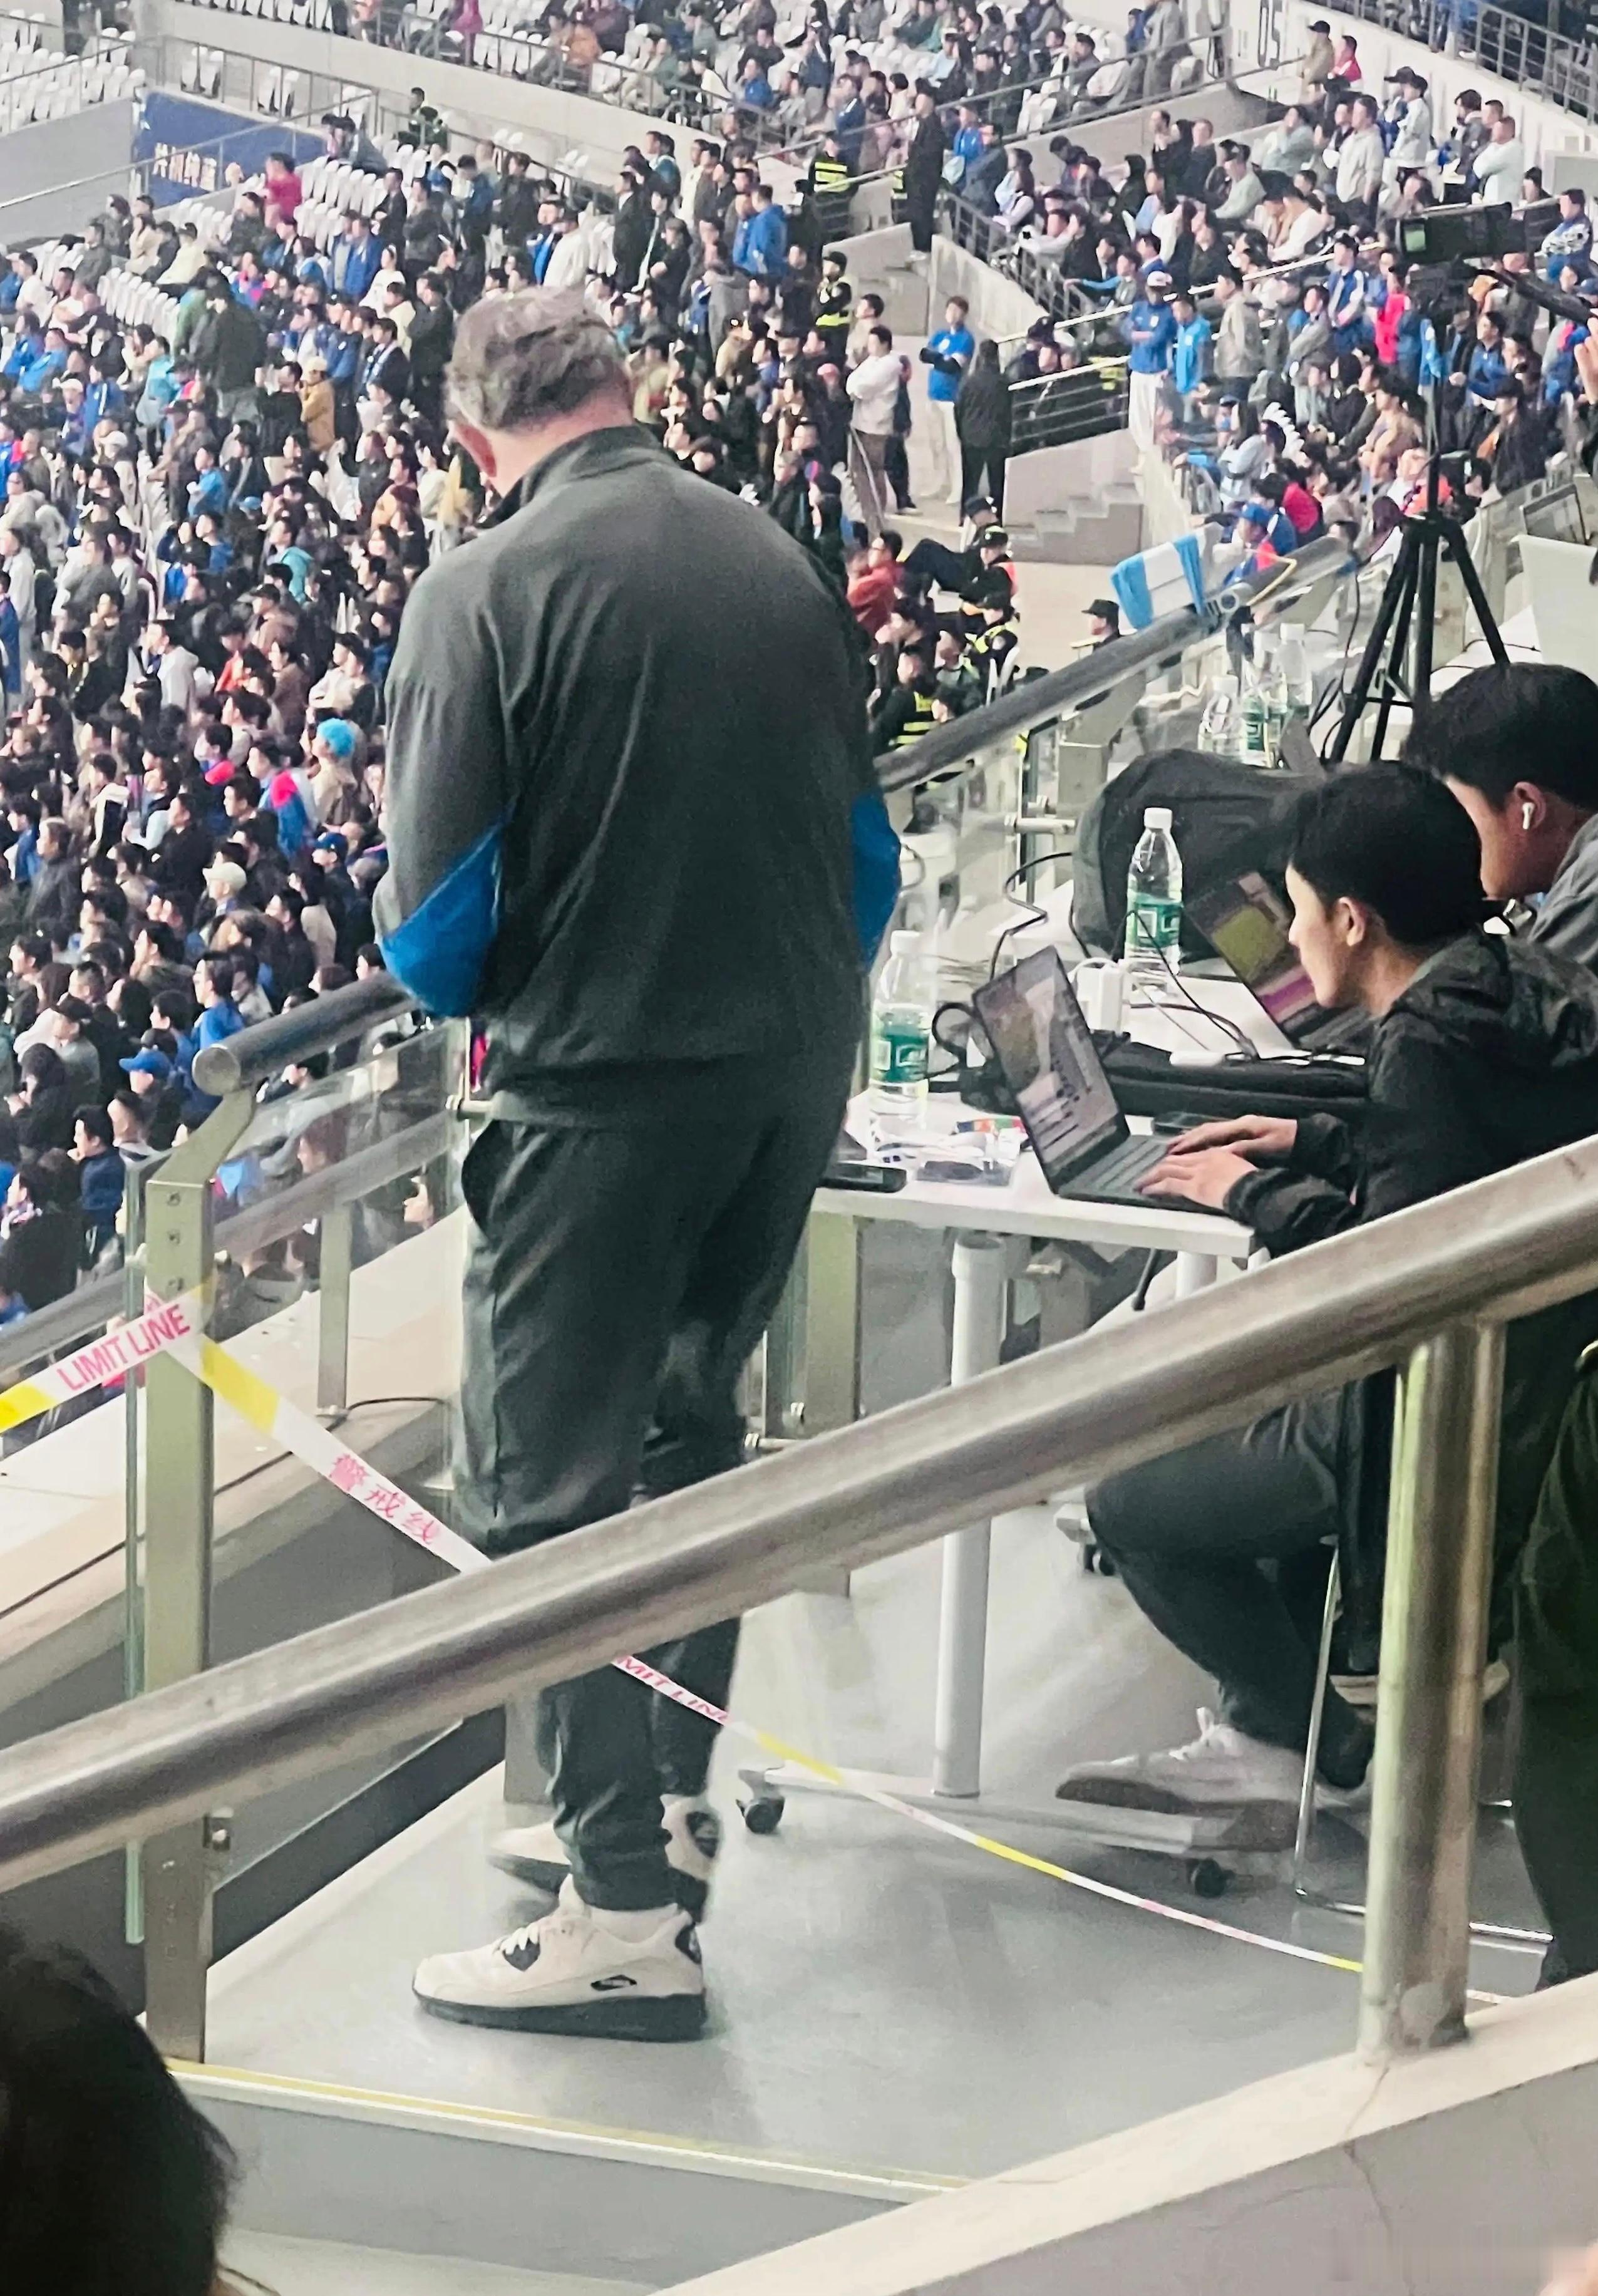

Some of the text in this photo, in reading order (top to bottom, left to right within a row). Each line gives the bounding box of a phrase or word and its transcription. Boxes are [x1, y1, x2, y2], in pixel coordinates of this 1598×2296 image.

[56, 1304, 190, 1390] LIMIT LINE
[329, 1454, 440, 1544] 警戒线
